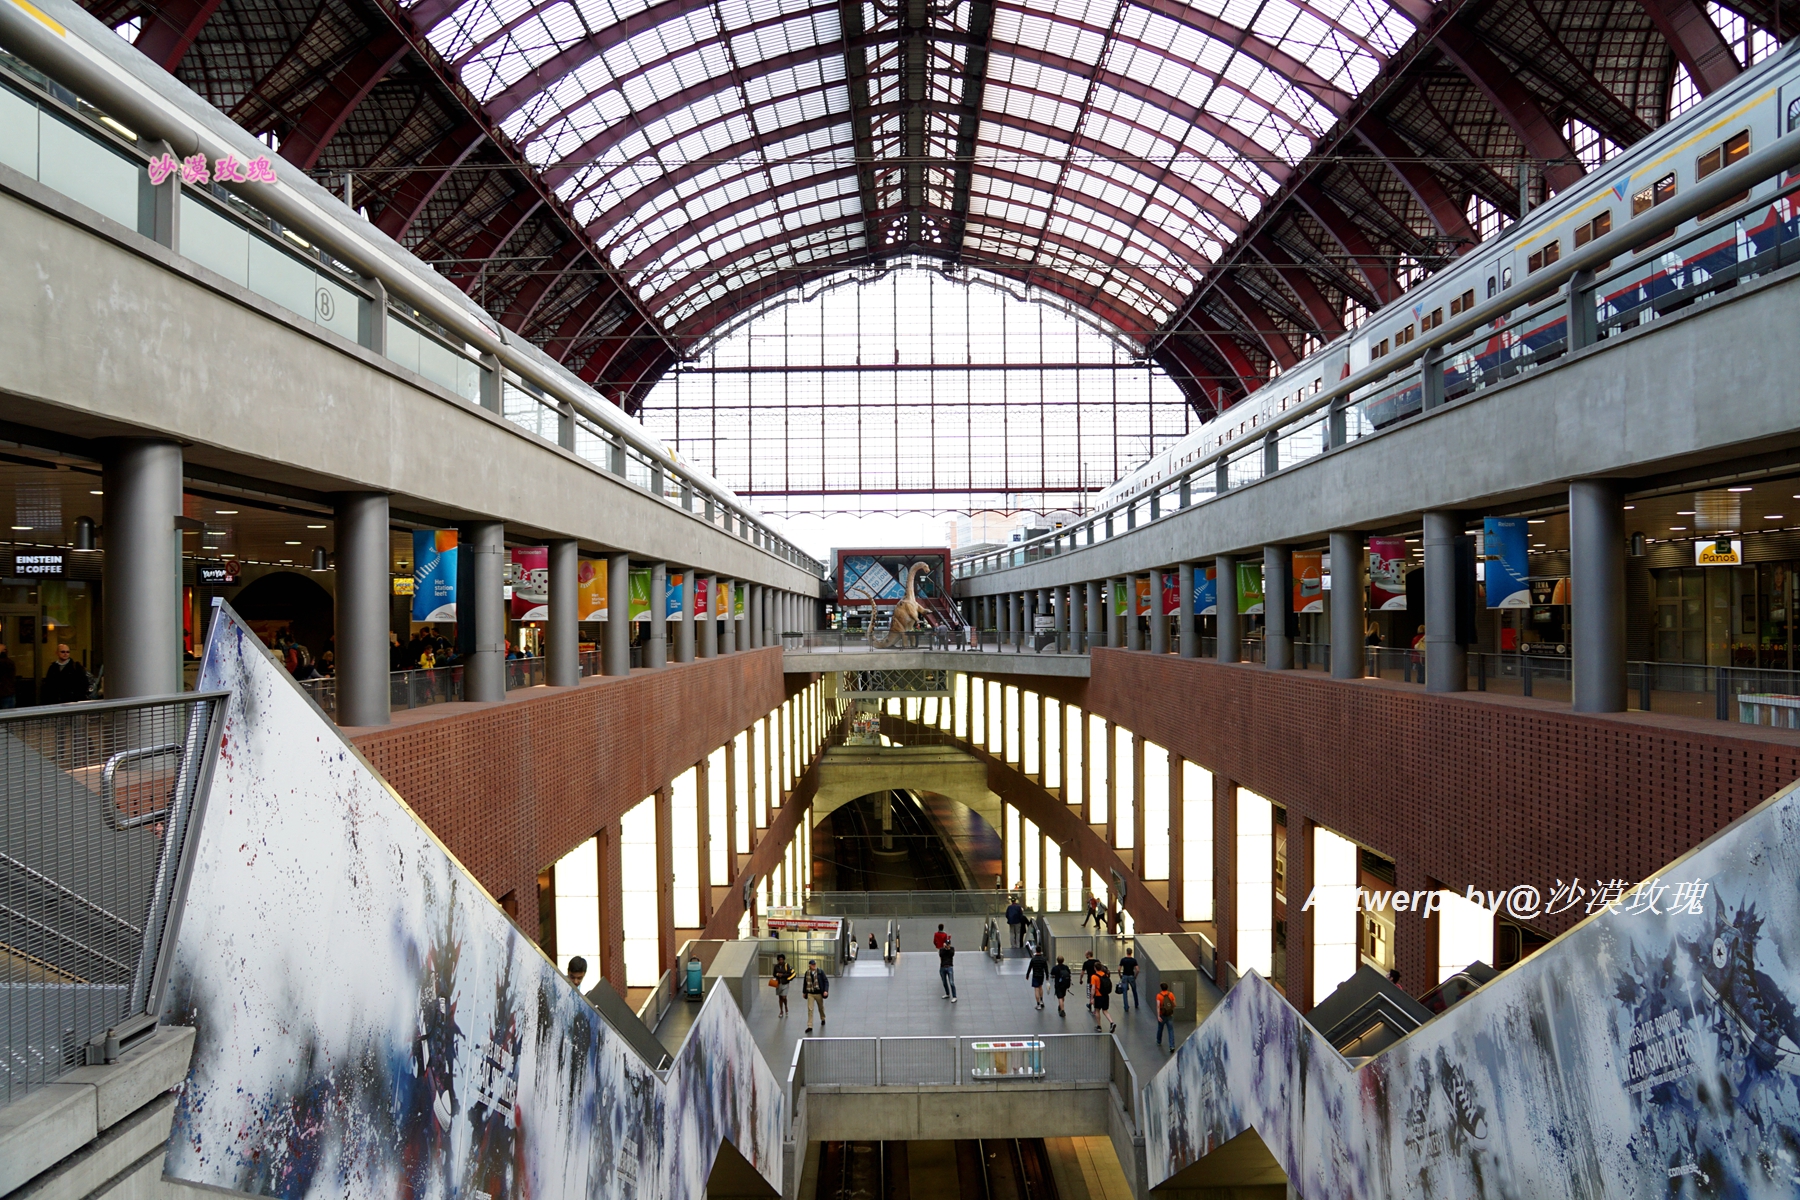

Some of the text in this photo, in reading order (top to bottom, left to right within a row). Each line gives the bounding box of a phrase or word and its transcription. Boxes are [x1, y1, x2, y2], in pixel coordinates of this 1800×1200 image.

[16, 555, 63, 564] EINSTEIN
[1703, 554, 1736, 562] Panos
[26, 565, 63, 573] COFFEE
[1646, 1029, 1698, 1071] SNEAKERS
